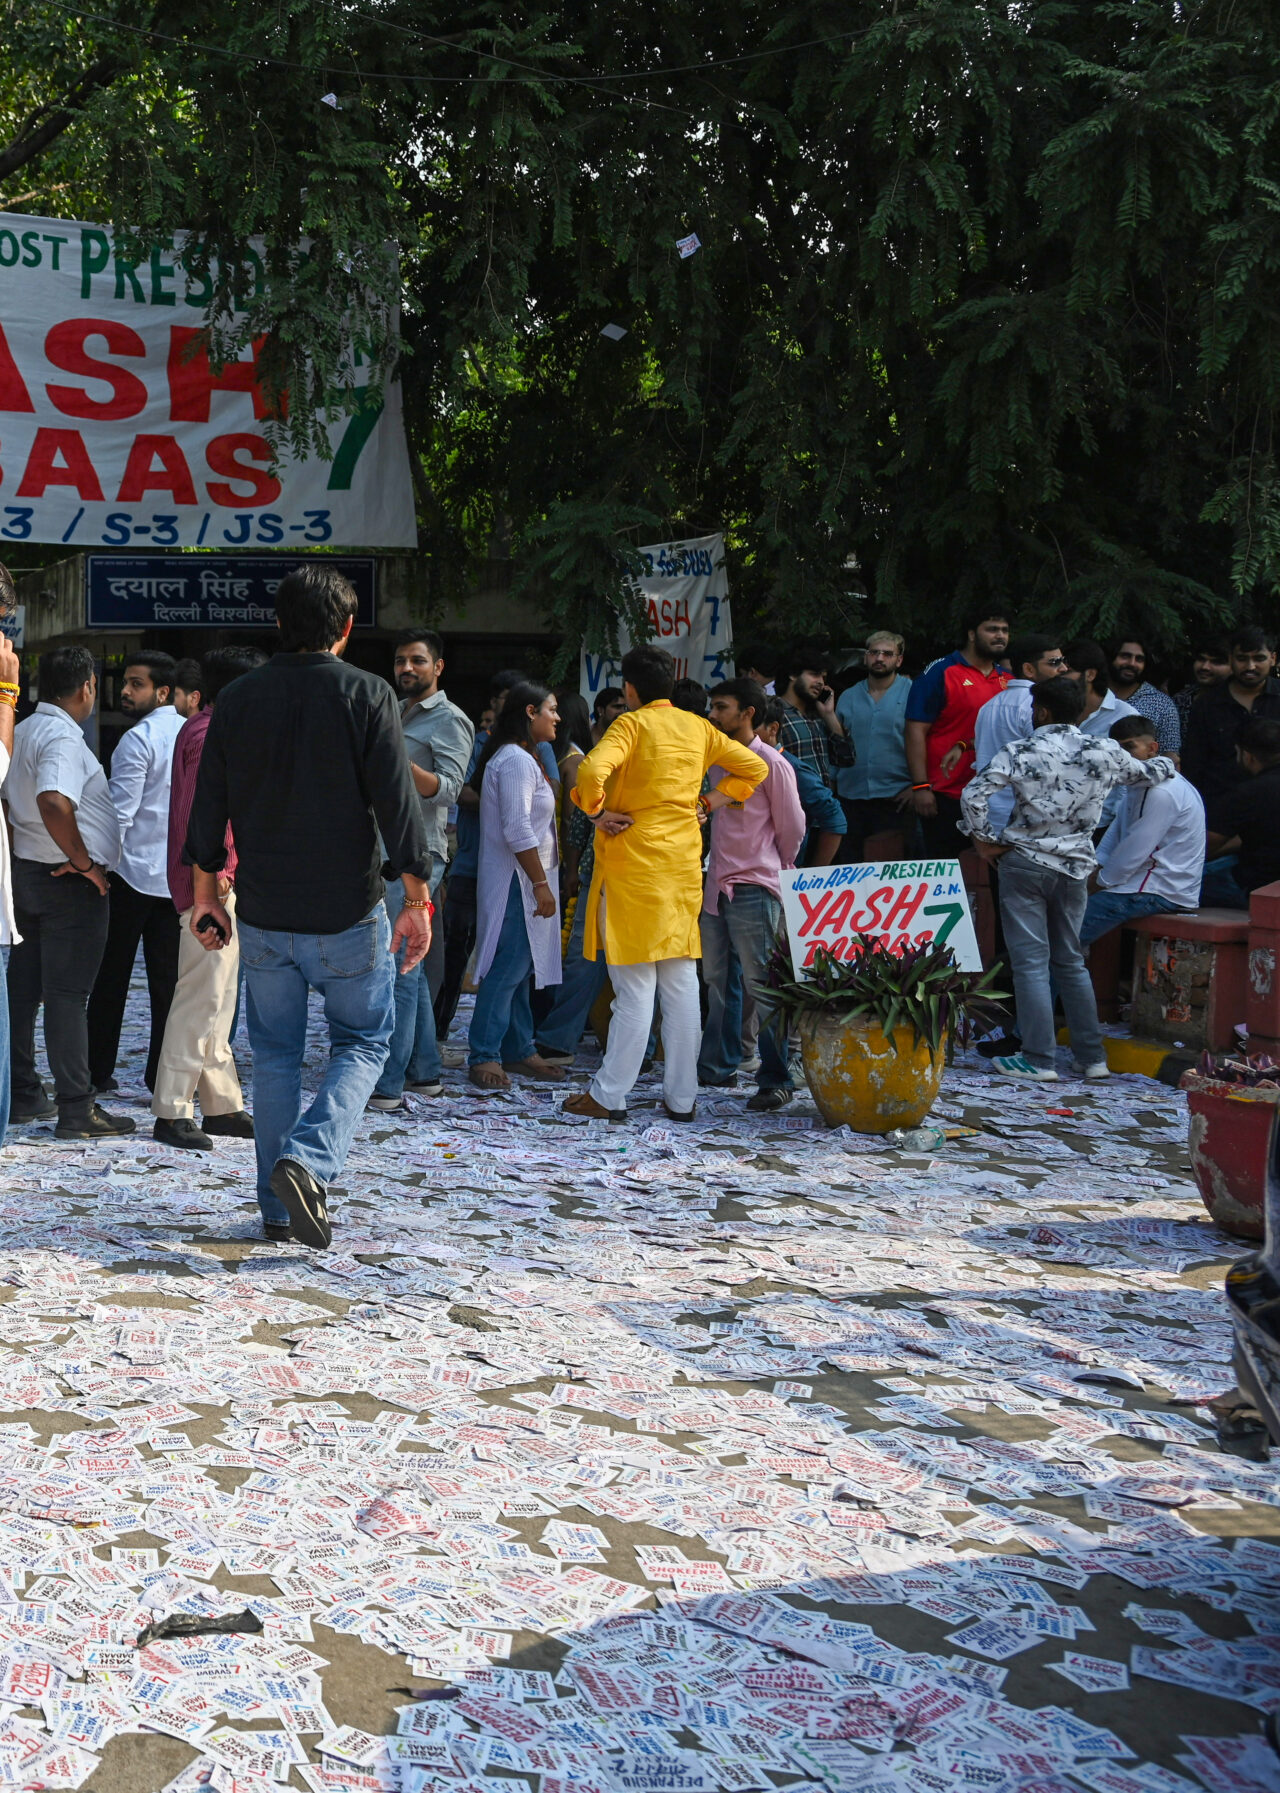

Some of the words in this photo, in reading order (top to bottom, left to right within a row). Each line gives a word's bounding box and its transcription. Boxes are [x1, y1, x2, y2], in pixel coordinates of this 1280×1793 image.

[101, 512, 179, 546] S-3
[223, 509, 333, 545] JS-3
[106, 576, 189, 600] दयाल
[198, 569, 254, 601] सिंह
[151, 601, 202, 622] दिल्ली
[638, 599, 691, 638] ASH
[705, 596, 721, 636] 7
[792, 873, 823, 892] Join
[933, 883, 962, 897] B.N.
[797, 882, 929, 937] YASH
[923, 902, 965, 948] 7
